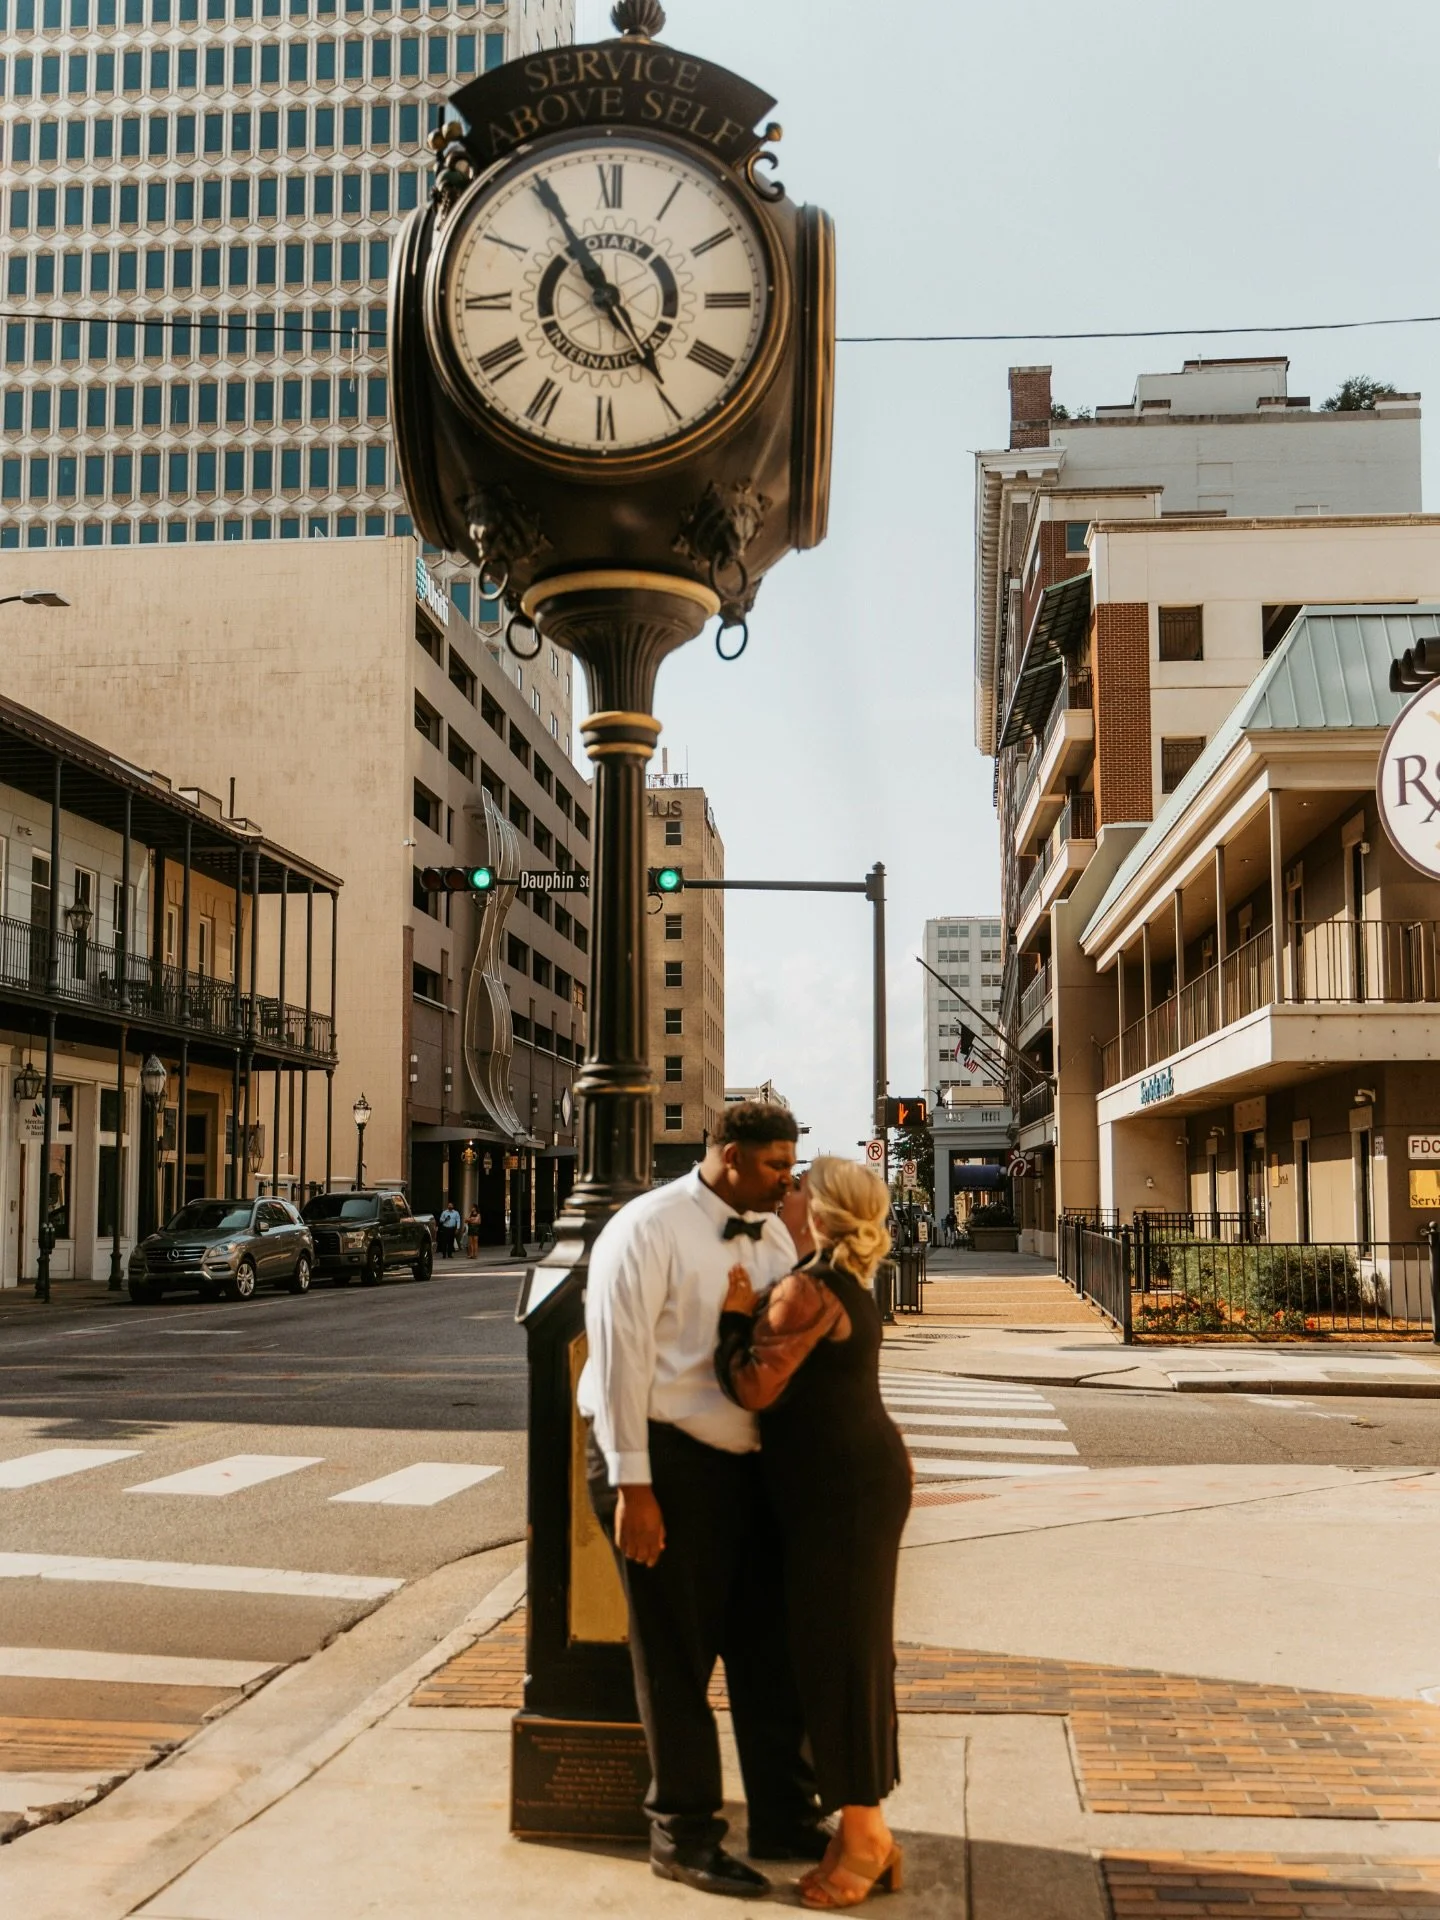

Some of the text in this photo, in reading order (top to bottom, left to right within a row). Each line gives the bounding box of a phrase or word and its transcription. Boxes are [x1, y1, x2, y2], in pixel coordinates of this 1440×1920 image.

[523, 49, 703, 94] SERVICE
[486, 87, 745, 153] ABOVE SELF
[584, 235, 645, 252] OTARY
[547, 327, 669, 369] INTERNATIOAL
[521, 871, 590, 892] Dauphin St
